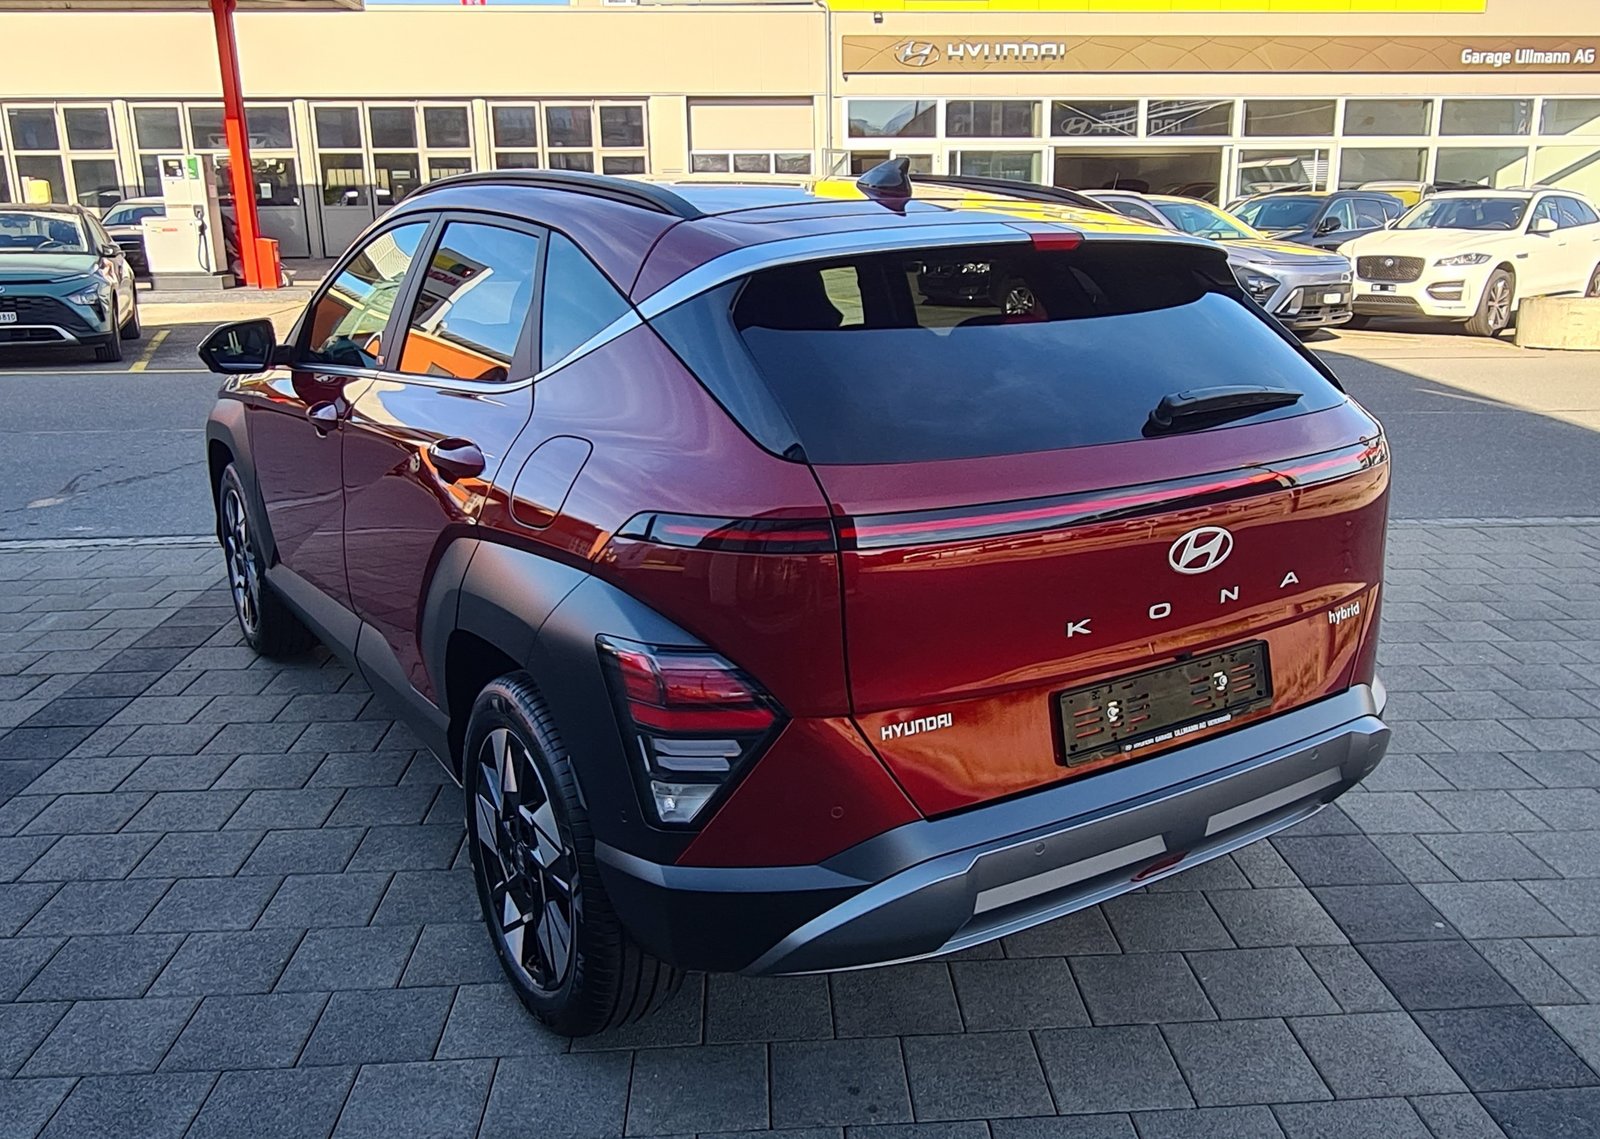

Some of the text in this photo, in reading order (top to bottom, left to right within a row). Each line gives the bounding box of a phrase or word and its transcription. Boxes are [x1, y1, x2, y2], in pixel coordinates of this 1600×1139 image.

[946, 43, 1066, 61] HYUNDAI
[1460, 48, 1596, 68] Garage Ullmann AG
[1066, 571, 1299, 638] KONA
[1328, 600, 1361, 625] hybrid
[881, 712, 953, 741] HYUNDAI
